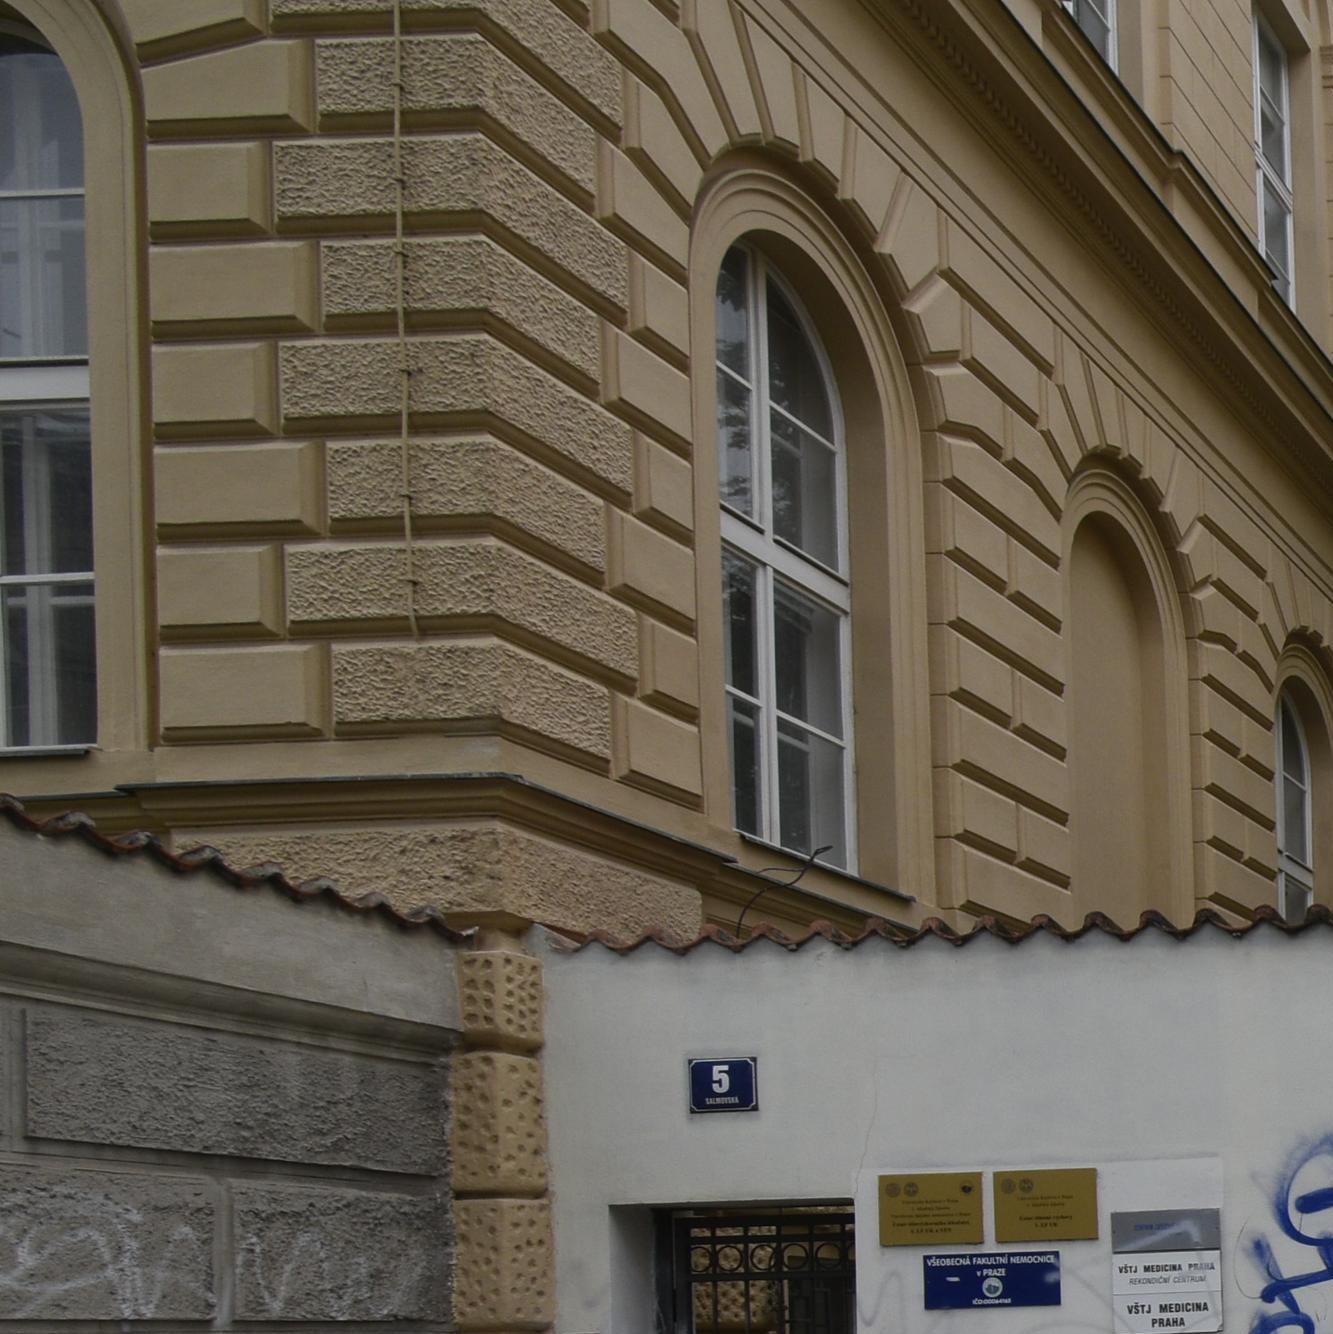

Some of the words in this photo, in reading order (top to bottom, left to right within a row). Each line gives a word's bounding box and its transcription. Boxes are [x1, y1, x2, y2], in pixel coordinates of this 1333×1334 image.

[712, 1065, 729, 1093] 5
[926, 1256, 970, 1267] VŠEOBECNÁ
[972, 1254, 1008, 1265] FAKULTNÍ
[1010, 1255, 1054, 1264] NEMOCNICE
[982, 1268, 1006, 1277] PRAZE
[1118, 1264, 1138, 1274] VŠTJ
[1143, 1264, 1182, 1273] MEDICINA
[1188, 1262, 1215, 1271] PRAHA
[1127, 1302, 1151, 1314] VŠTJ
[1158, 1302, 1209, 1313] MEDICINA
[1151, 1317, 1185, 1328] PRAHA
